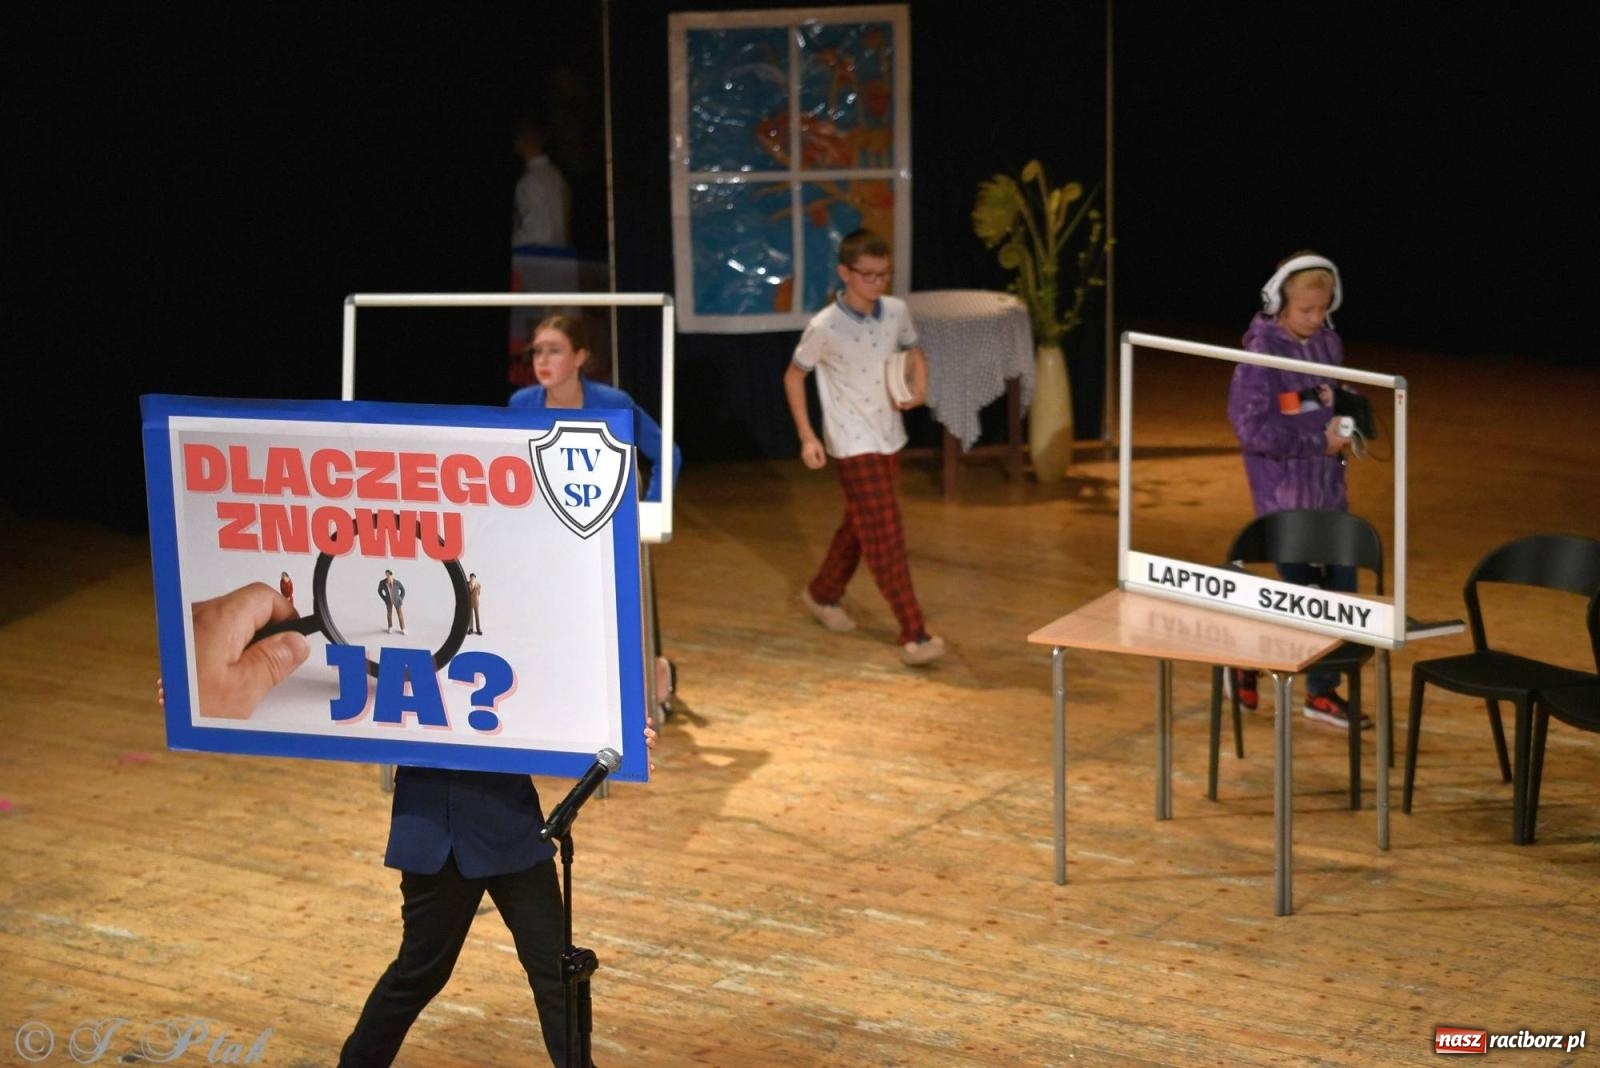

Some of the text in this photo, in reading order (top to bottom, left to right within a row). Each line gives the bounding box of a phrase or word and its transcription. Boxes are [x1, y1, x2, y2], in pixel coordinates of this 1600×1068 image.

[183, 444, 533, 506] DLACZEGO
[560, 447, 602, 473] TV
[564, 483, 602, 508] SP
[216, 501, 465, 561] ZNOWU
[1148, 562, 1236, 599] LAPTOP
[1258, 588, 1371, 628] SZKOLNY
[325, 644, 516, 734] JA?
